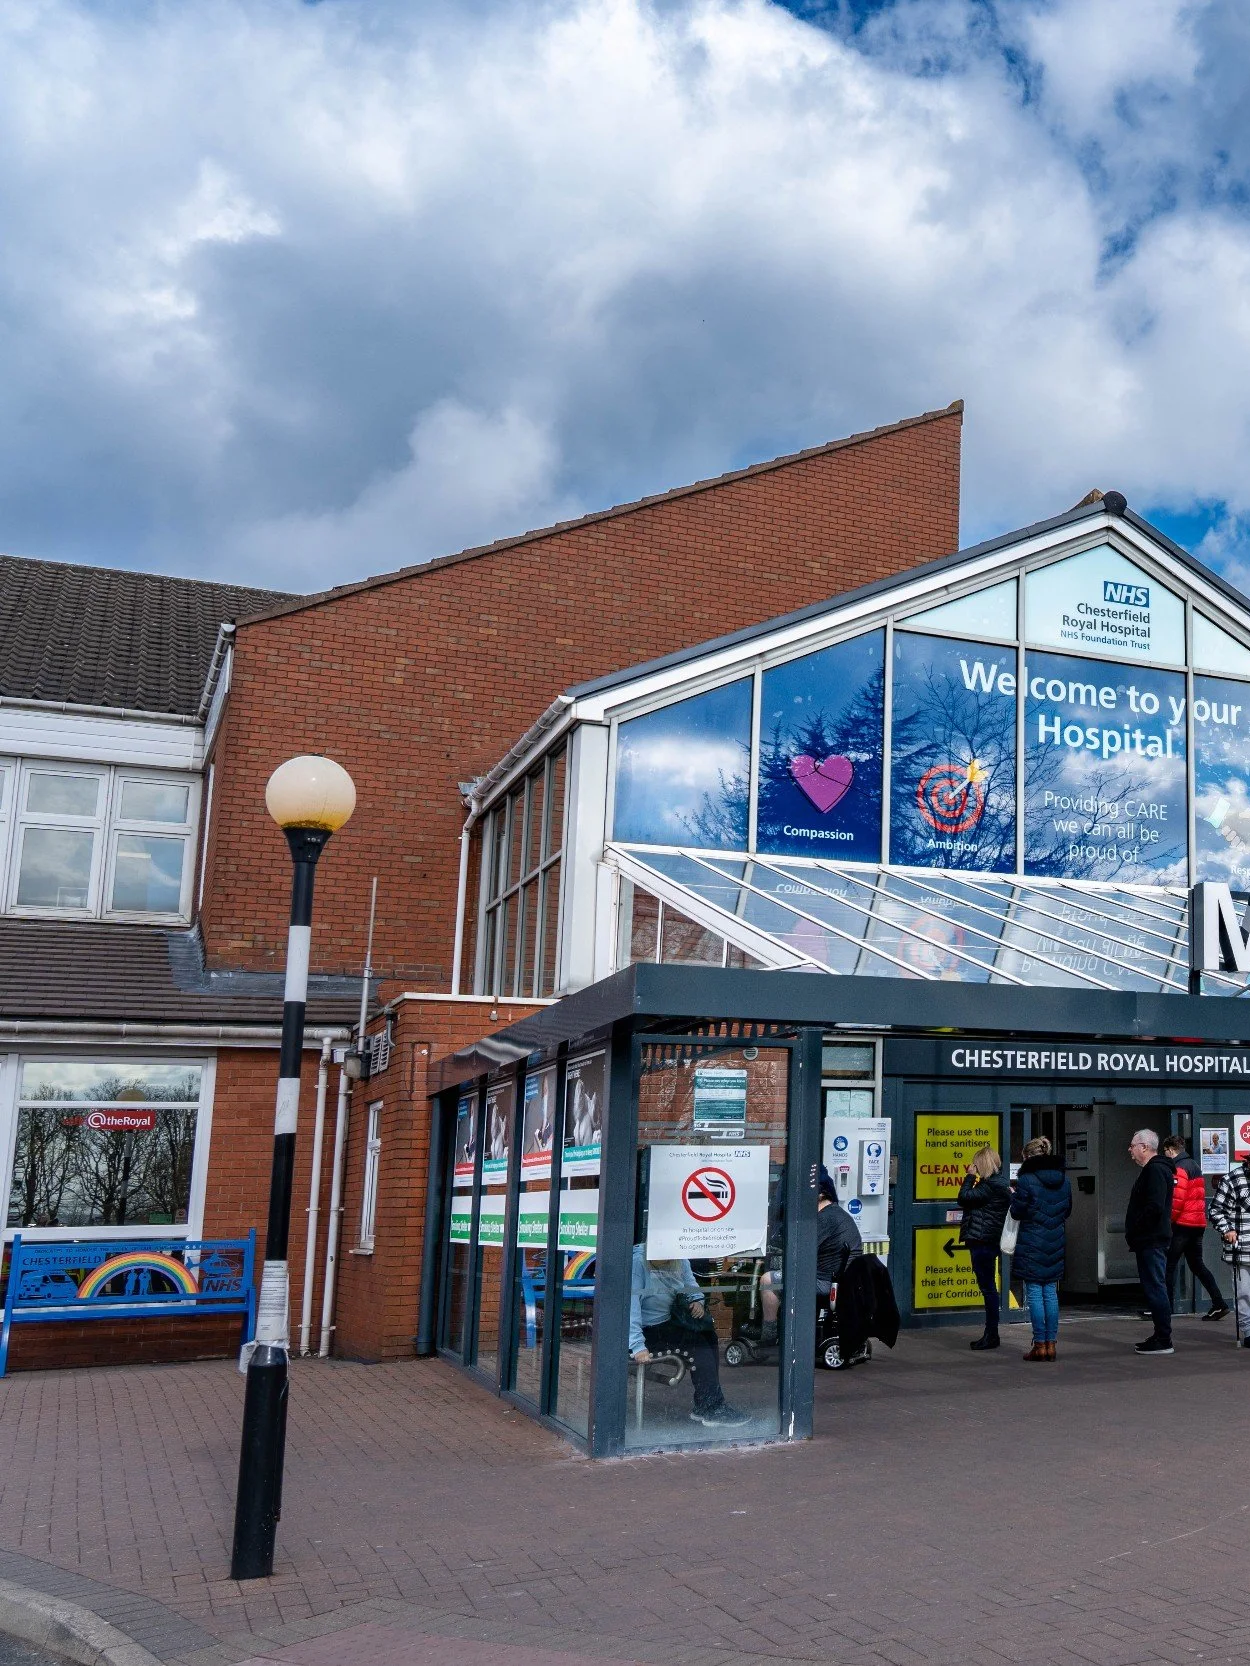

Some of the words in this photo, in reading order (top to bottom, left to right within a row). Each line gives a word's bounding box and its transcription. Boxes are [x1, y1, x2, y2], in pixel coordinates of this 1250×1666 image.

[1104, 582, 1148, 606] NHS
[1077, 602, 1150, 624] Chesterfield
[1062, 614, 1097, 631] Royal
[1101, 620, 1151, 639] Hospital
[1060, 629, 1079, 640] NHS
[1081, 633, 1128, 647] Foundation
[1130, 639, 1151, 650] Trust
[960, 659, 1117, 709] Welcome
[1126, 685, 1160, 715] to
[1168, 694, 1242, 727] your
[1038, 714, 1173, 759] Hospital
[1044, 790, 1119, 819] Providing
[1124, 799, 1168, 821] CARE
[783, 824, 855, 842] Compassion
[1053, 818, 1078, 834] we
[1083, 821, 1111, 838] can
[1117, 821, 1135, 840] all
[1140, 824, 1160, 843] be
[927, 838, 979, 852] Ambition
[1068, 842, 1117, 862] proud
[951, 1048, 1093, 1070] CHESTERFIELD
[1097, 1053, 1160, 1073] ROYAL
[927, 1127, 955, 1137] Please
[957, 1129, 973, 1137] use
[975, 1127, 989, 1136] the
[925, 1138, 948, 1148] hand
[950, 1138, 991, 1148] sanitisers
[953, 1151, 963, 1159] to
[919, 1164, 959, 1175] CLEAN
[936, 1176, 964, 1187] HAN
[22, 1255, 102, 1267] CHESTERFIELD
[925, 1265, 954, 1274] Please
[205, 1279, 241, 1293] NHS
[921, 1278, 936, 1287] the
[938, 1277, 954, 1286] left
[956, 1278, 968, 1286] on
[927, 1291, 943, 1300] our
[945, 1289, 982, 1299] Corridor
